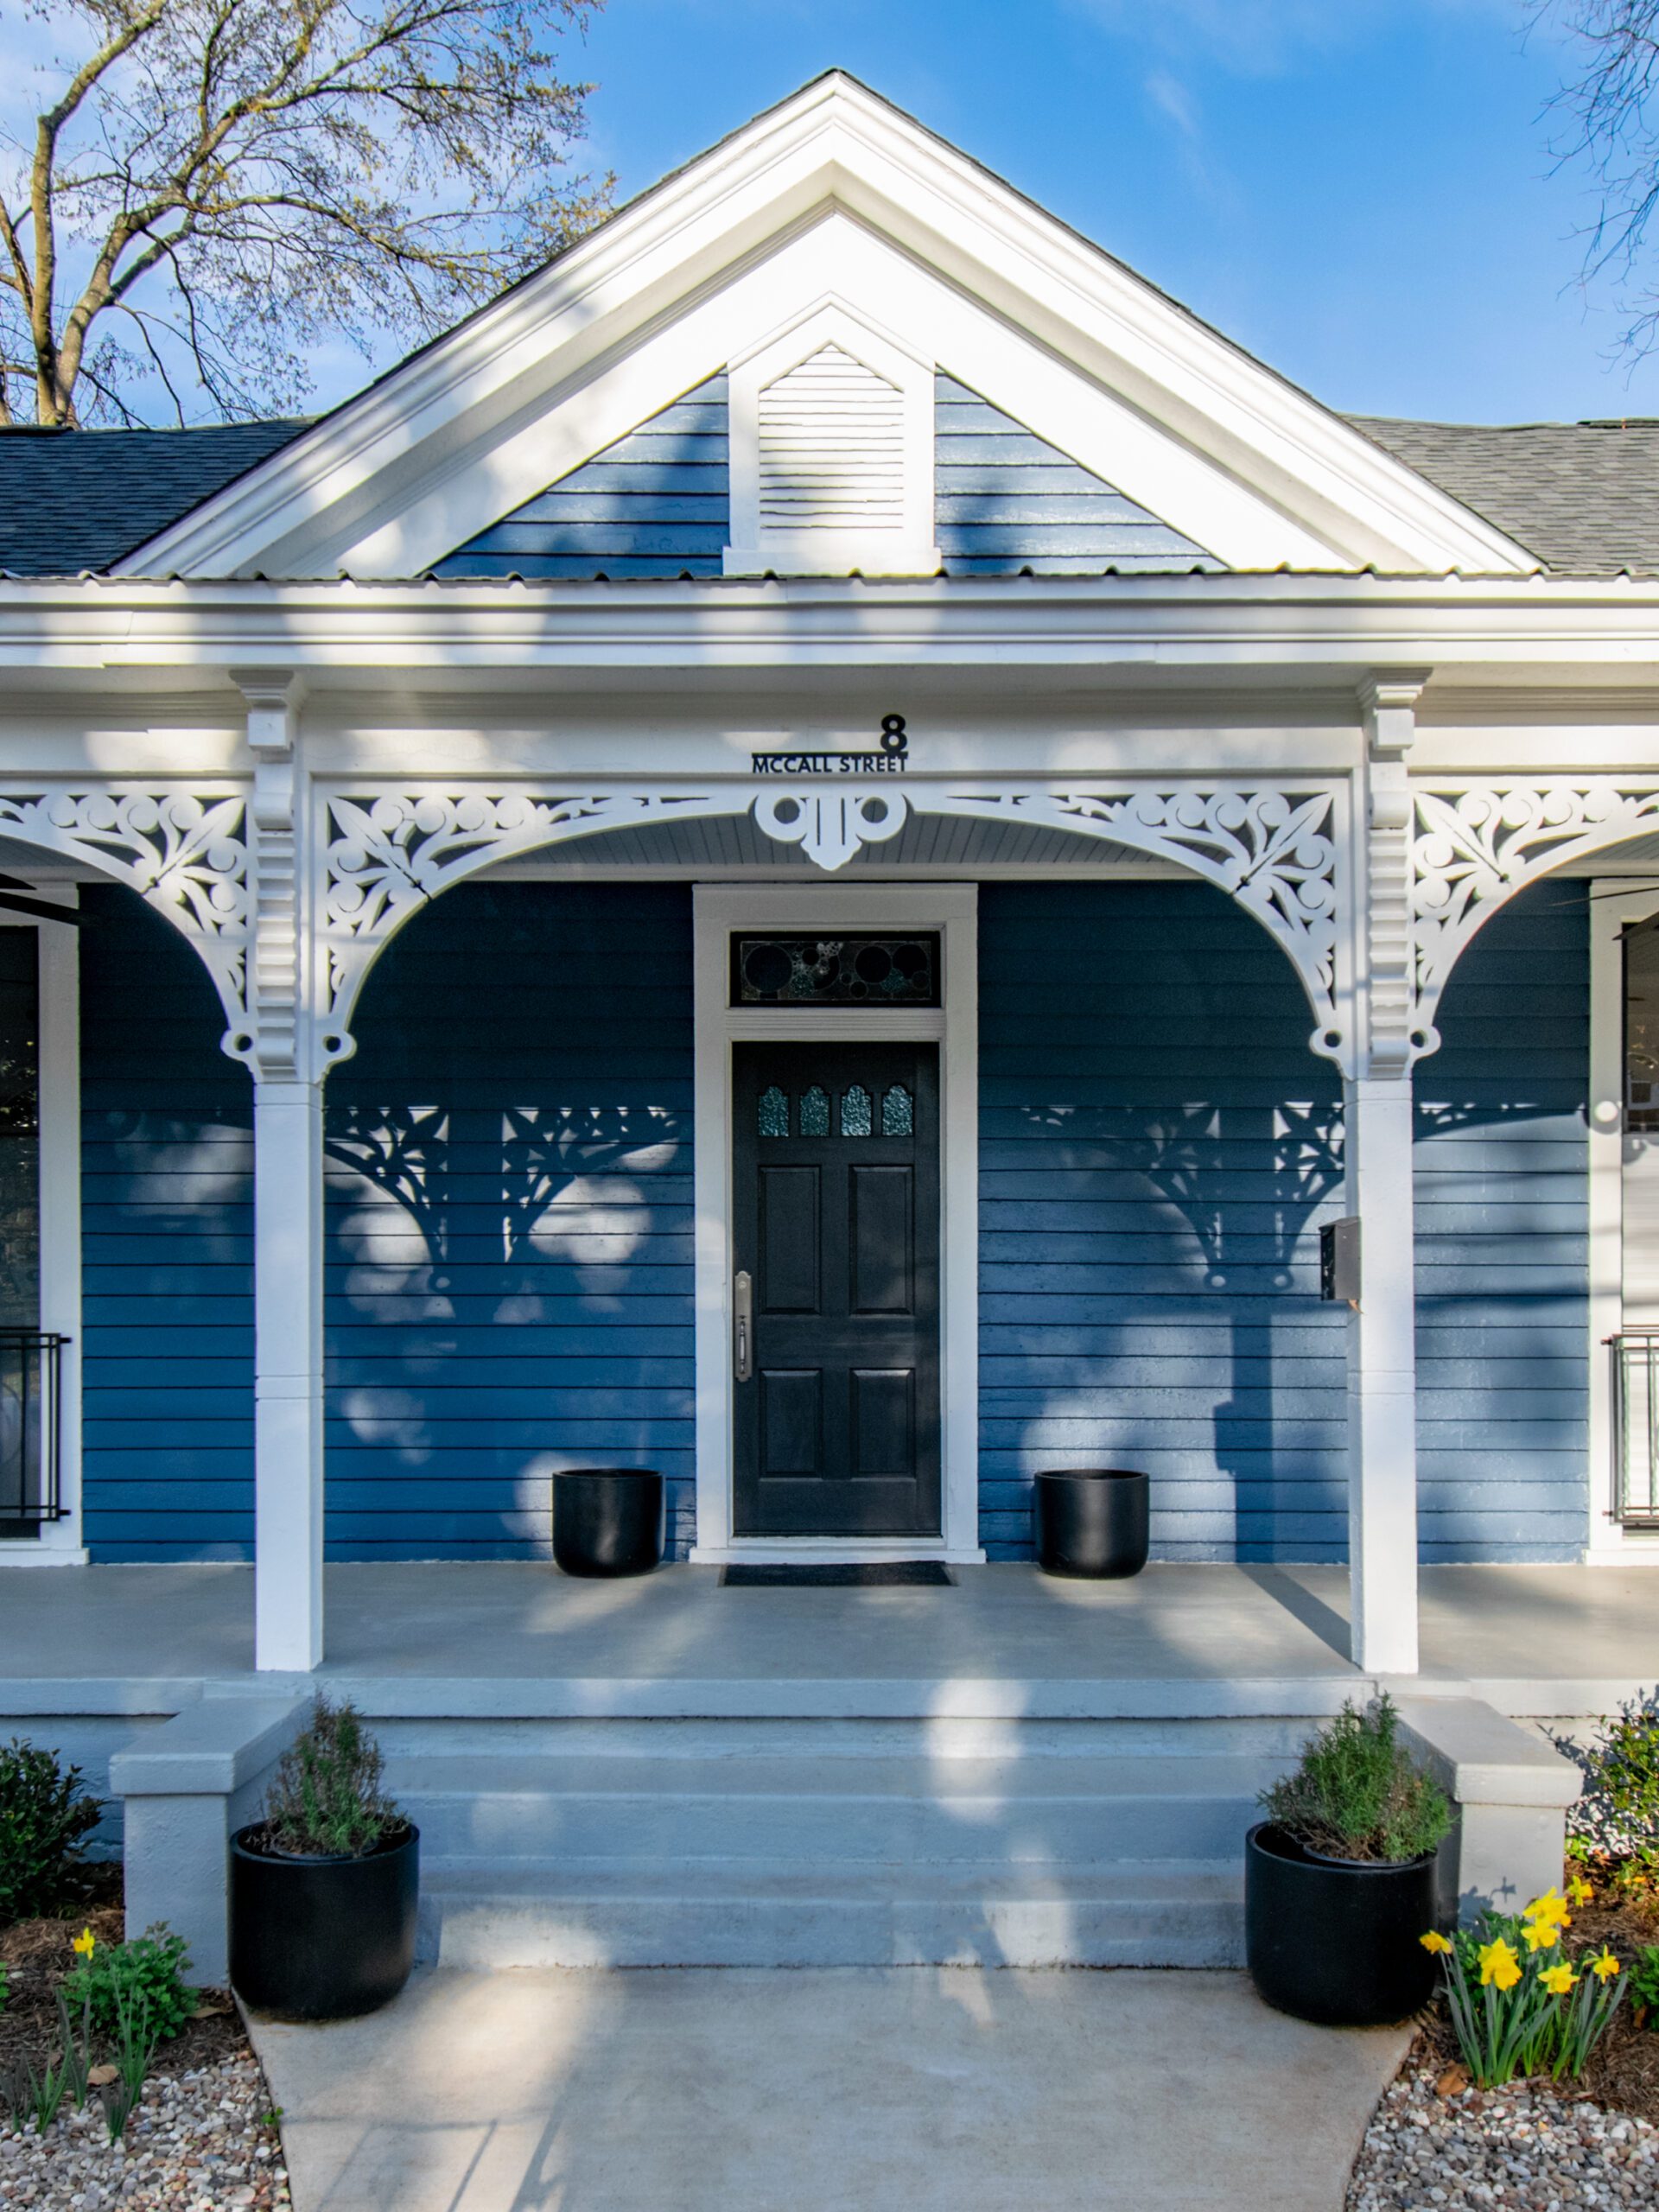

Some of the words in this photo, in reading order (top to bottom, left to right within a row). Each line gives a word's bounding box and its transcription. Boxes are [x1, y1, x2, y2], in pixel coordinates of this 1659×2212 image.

[880, 714, 907, 753] 8
[752, 754, 832, 773] MCCALL
[839, 754, 906, 773] STREET
